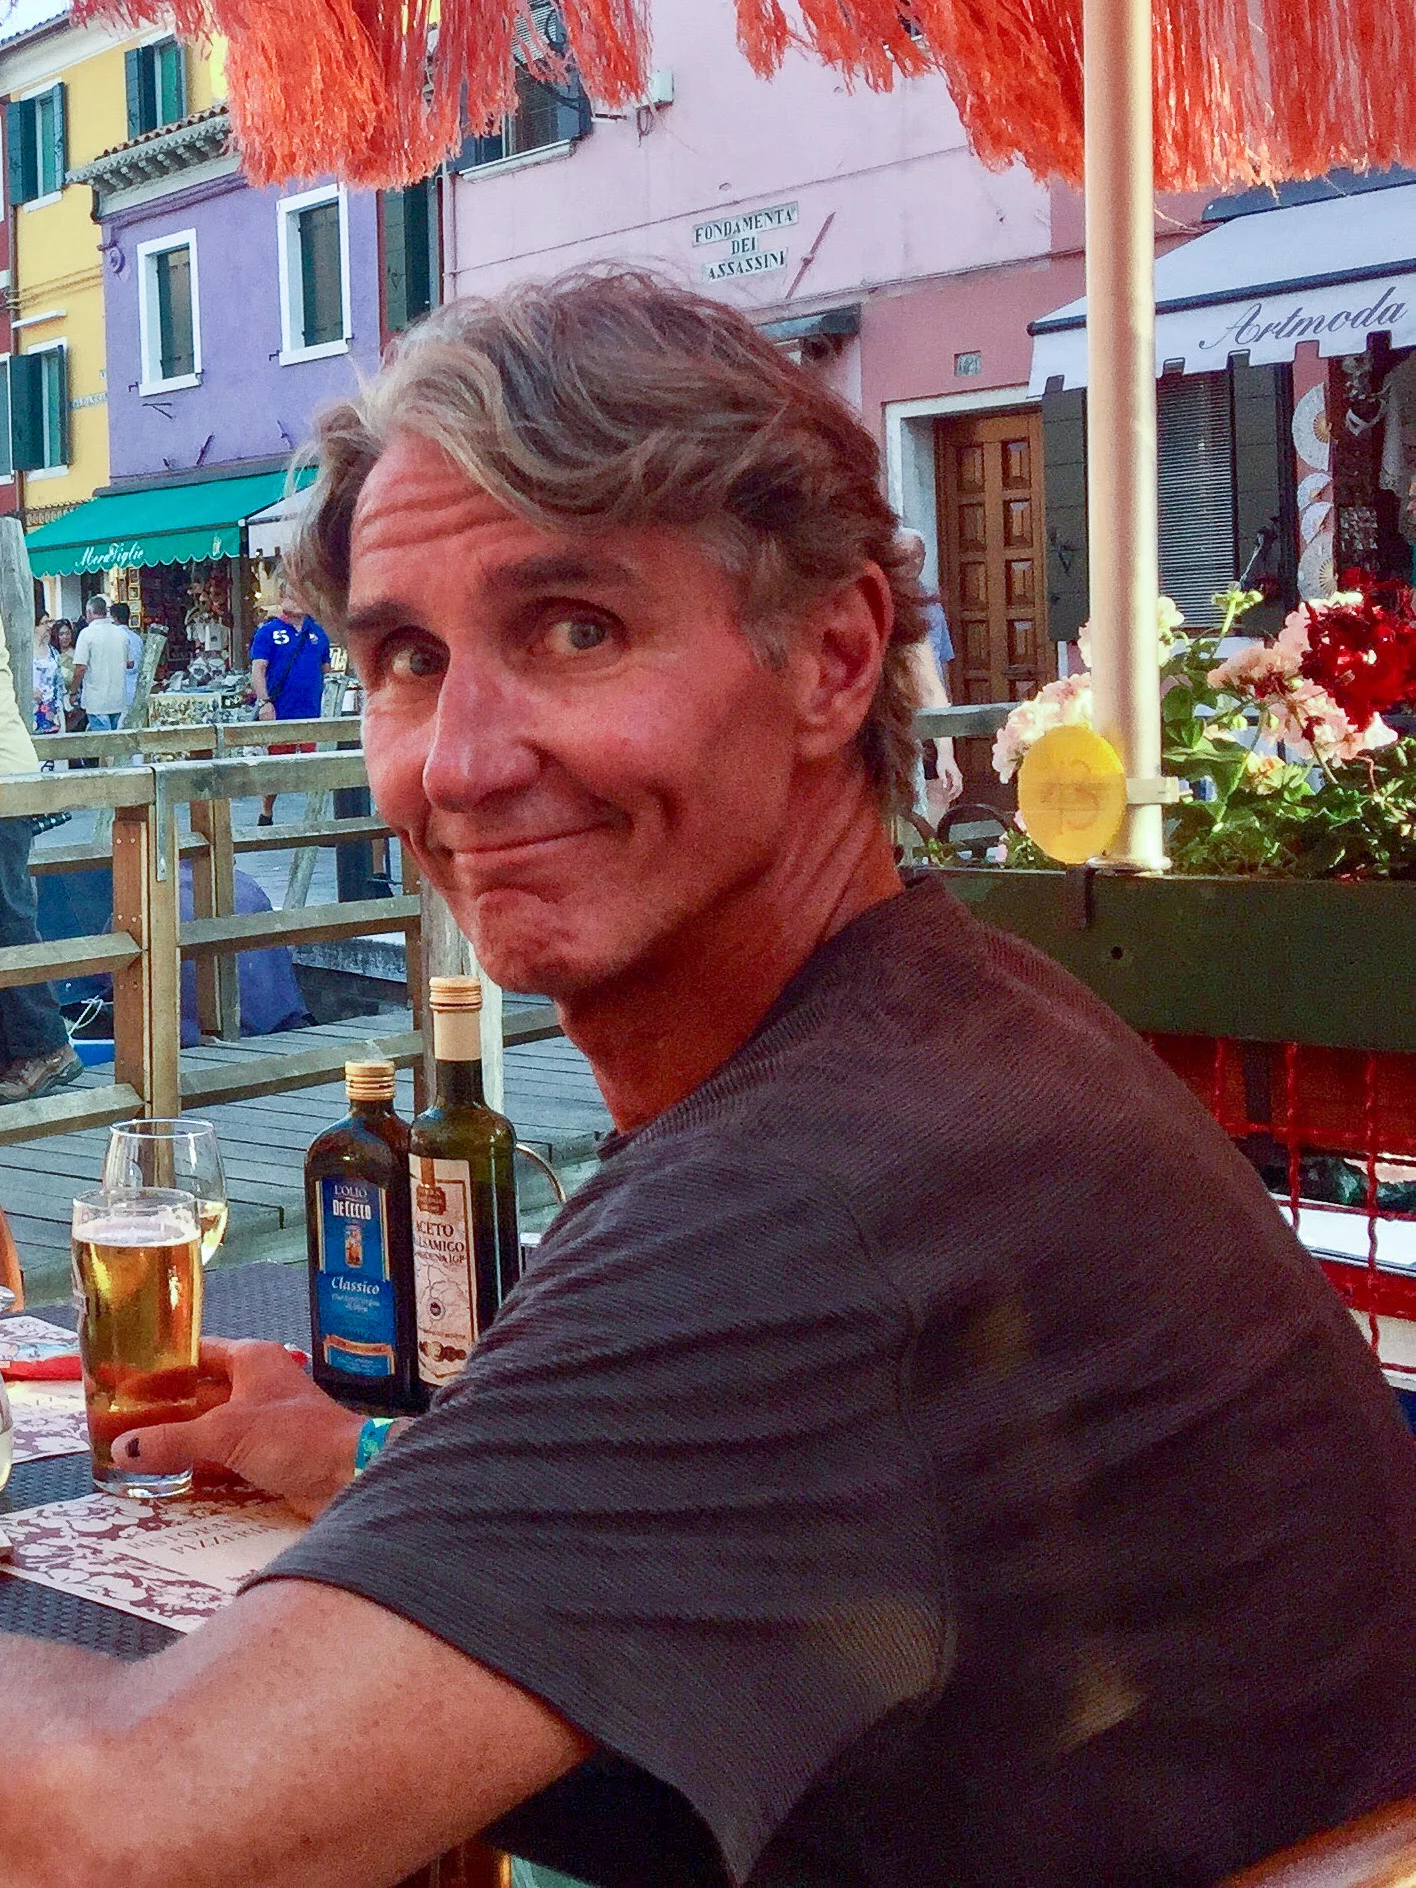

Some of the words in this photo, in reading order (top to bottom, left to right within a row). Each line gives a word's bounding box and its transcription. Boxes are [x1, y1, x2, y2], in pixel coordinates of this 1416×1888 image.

[694, 207, 793, 243] FONDAMENTA
[731, 236, 756, 255] DEI
[708, 250, 784, 280] ASSASSINI
[1198, 286, 1409, 350] Artmoda
[272, 629, 290, 645] 5
[331, 1275, 380, 1295] Classico
